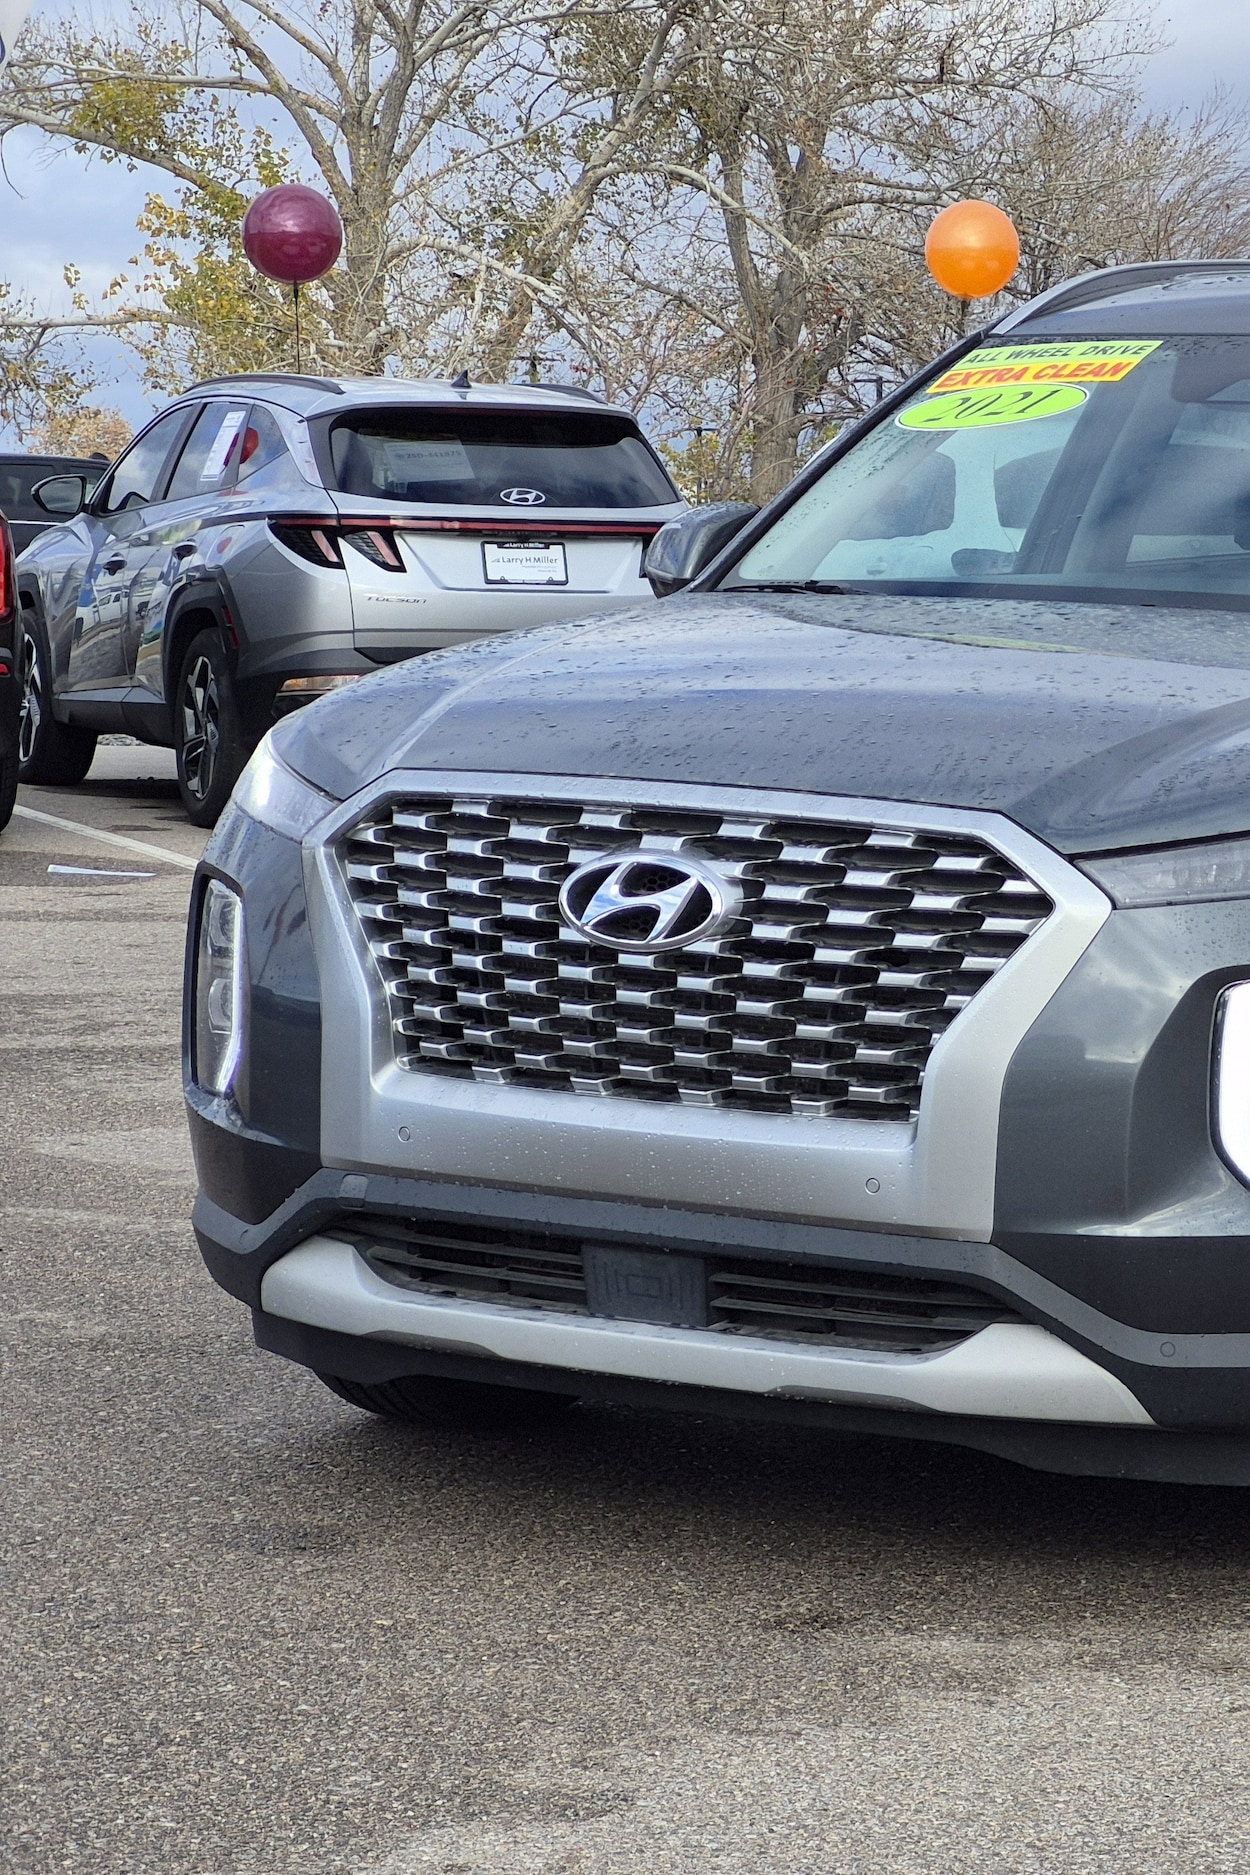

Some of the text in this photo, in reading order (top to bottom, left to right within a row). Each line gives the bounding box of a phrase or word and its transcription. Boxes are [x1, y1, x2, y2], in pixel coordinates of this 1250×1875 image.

[963, 344, 1152, 364] ALL WHEEL DRIVE
[937, 361, 1132, 389] EXTRA CLEAN
[922, 388, 1063, 423] 2021
[501, 556, 524, 565] Larry
[533, 556, 558, 564] Miller
